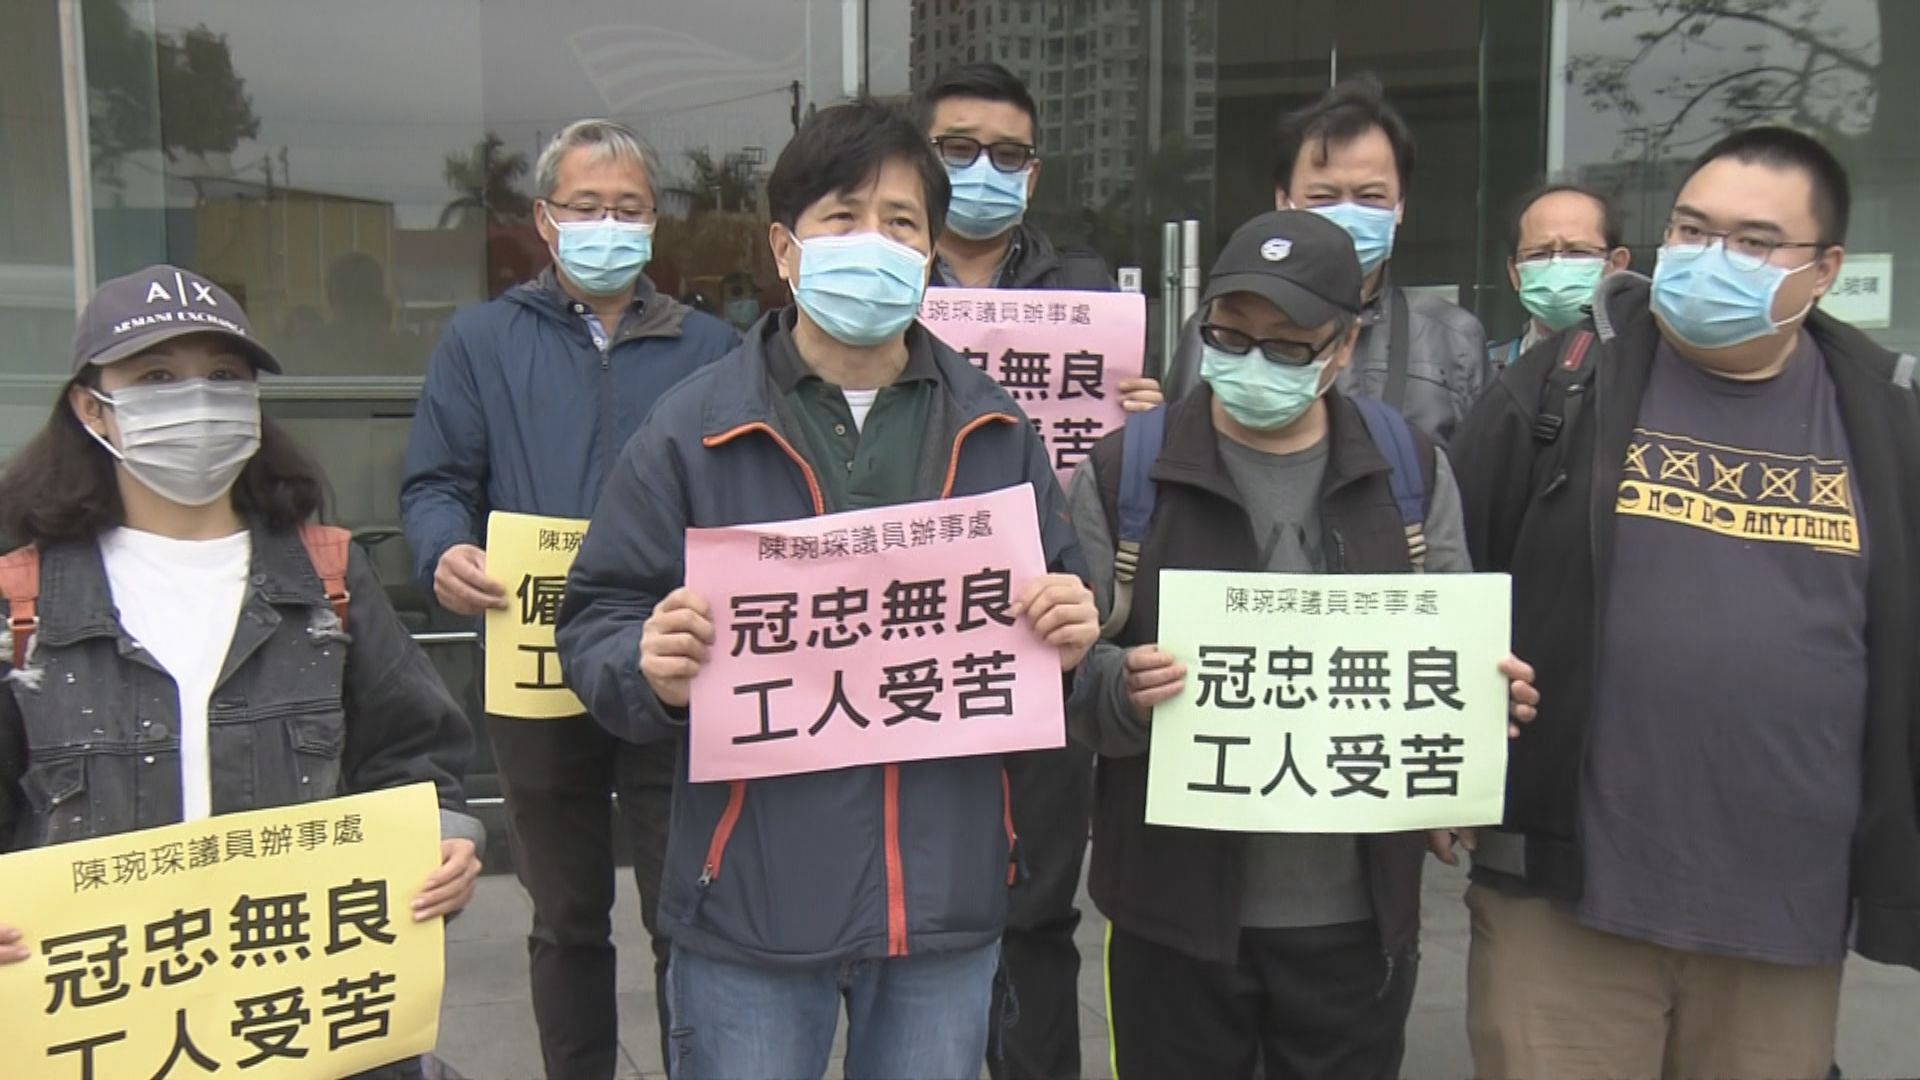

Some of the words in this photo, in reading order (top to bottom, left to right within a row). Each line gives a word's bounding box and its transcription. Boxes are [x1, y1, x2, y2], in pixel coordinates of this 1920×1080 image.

[113, 311, 173, 335] ARMANI
[919, 299, 1091, 325] 琬琛議員辦事處
[757, 510, 993, 561] 陳琬琛議員辦事處
[1648, 489, 1695, 519] NOT
[1702, 501, 1736, 529] DO
[1743, 509, 1851, 543] ANYTHING
[730, 567, 1017, 658] 冠忠無良
[731, 649, 1017, 745] 工人受苦
[1195, 645, 1467, 712] 冠忠無良
[1187, 732, 1465, 799] 工人受苦
[72, 813, 364, 893] 陳琬琛議員辦事處
[40, 877, 398, 1015] 冠忠無良
[46, 970, 397, 1080] 工人受苦
